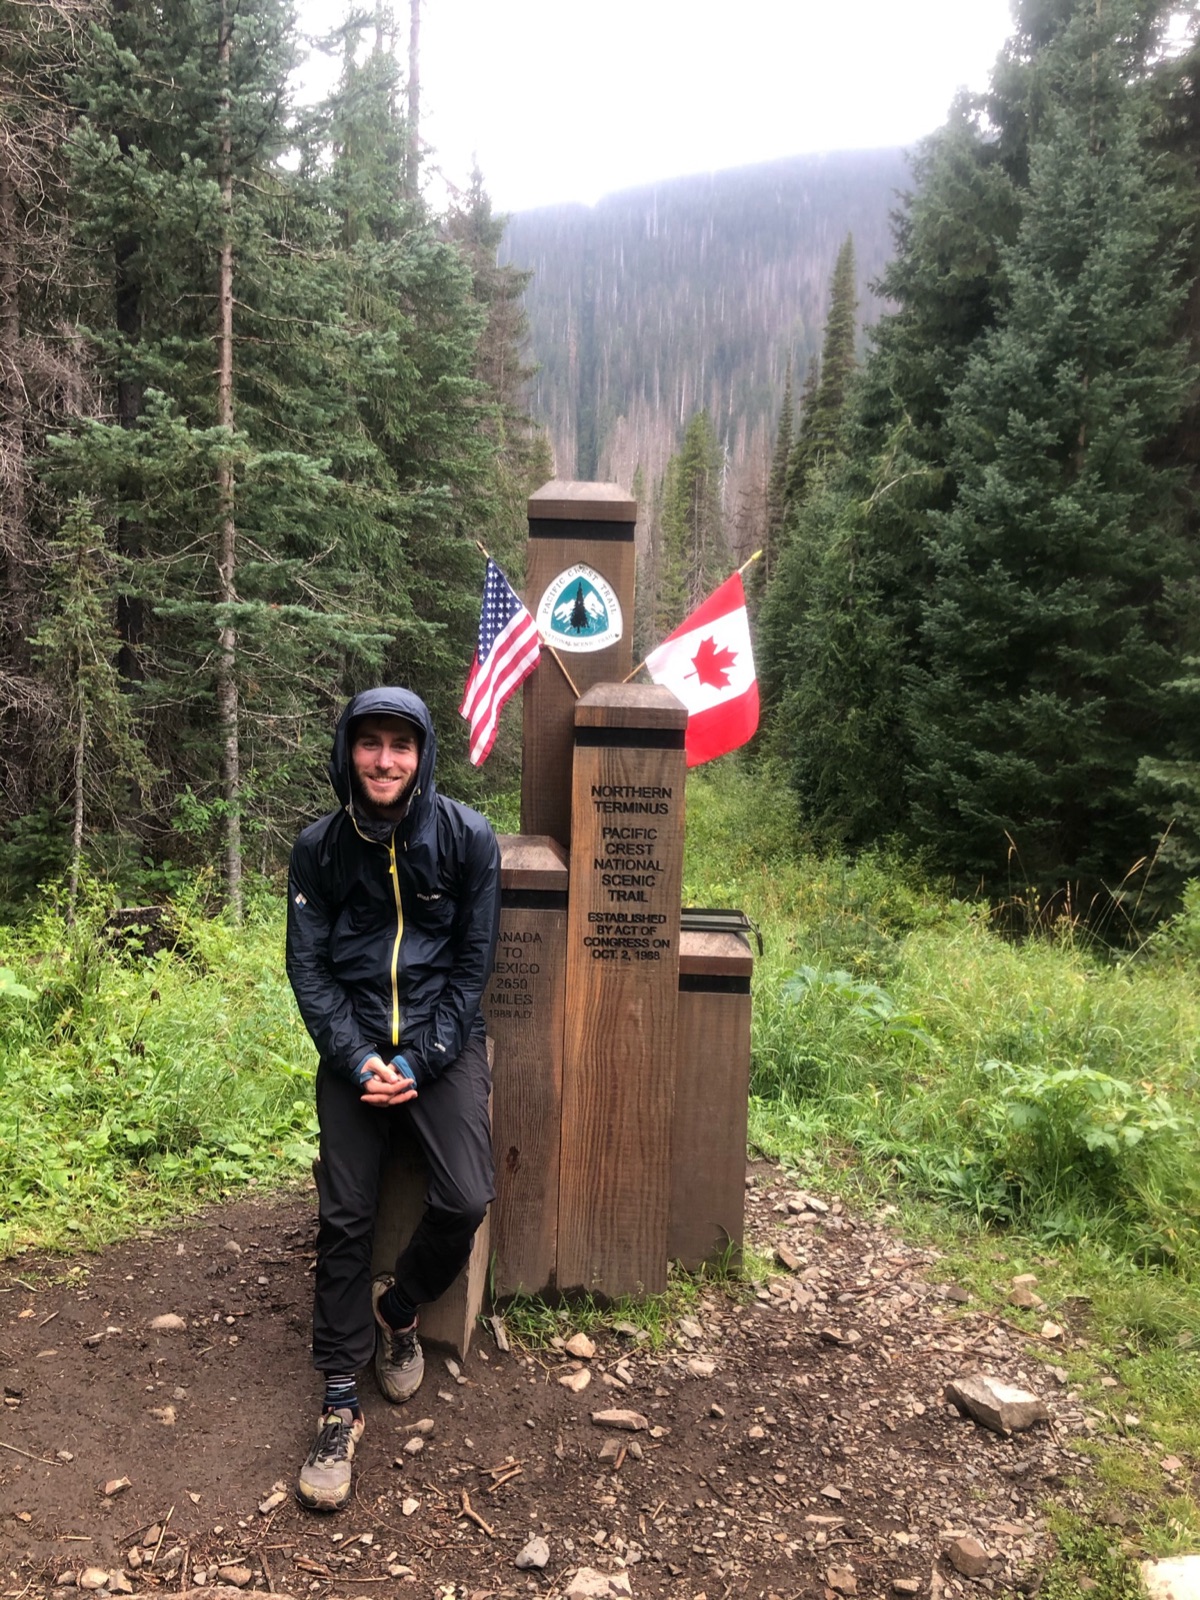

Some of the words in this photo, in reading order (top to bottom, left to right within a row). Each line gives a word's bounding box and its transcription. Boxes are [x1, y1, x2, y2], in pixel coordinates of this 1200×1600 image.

[542, 578, 566, 614] PACIFIC
[567, 565, 598, 581] CREST
[600, 584, 617, 614] TRAIL
[591, 785, 672, 798] NORTHERN
[594, 801, 669, 814] TERMINUS
[602, 827, 658, 840] PACIFIC
[606, 842, 654, 855] CREST
[594, 858, 664, 872] NATIONAL
[602, 874, 656, 887] SCENIC
[608, 890, 648, 902] TRAIL
[588, 912, 666, 924] ESTABLISHED
[597, 925, 613, 935] BY
[614, 926, 638, 936] ACT
[641, 926, 658, 936] OF
[497, 931, 542, 943] ANADA
[584, 936, 650, 948] CONGRESS
[652, 938, 670, 948] ON
[502, 946, 522, 958] TO
[592, 950, 618, 960] OCT.
[621, 950, 632, 961] 2,
[635, 950, 660, 960] 1968
[494, 962, 540, 974] EXICO
[496, 978, 528, 990] 2650
[490, 993, 532, 1005] MILES
